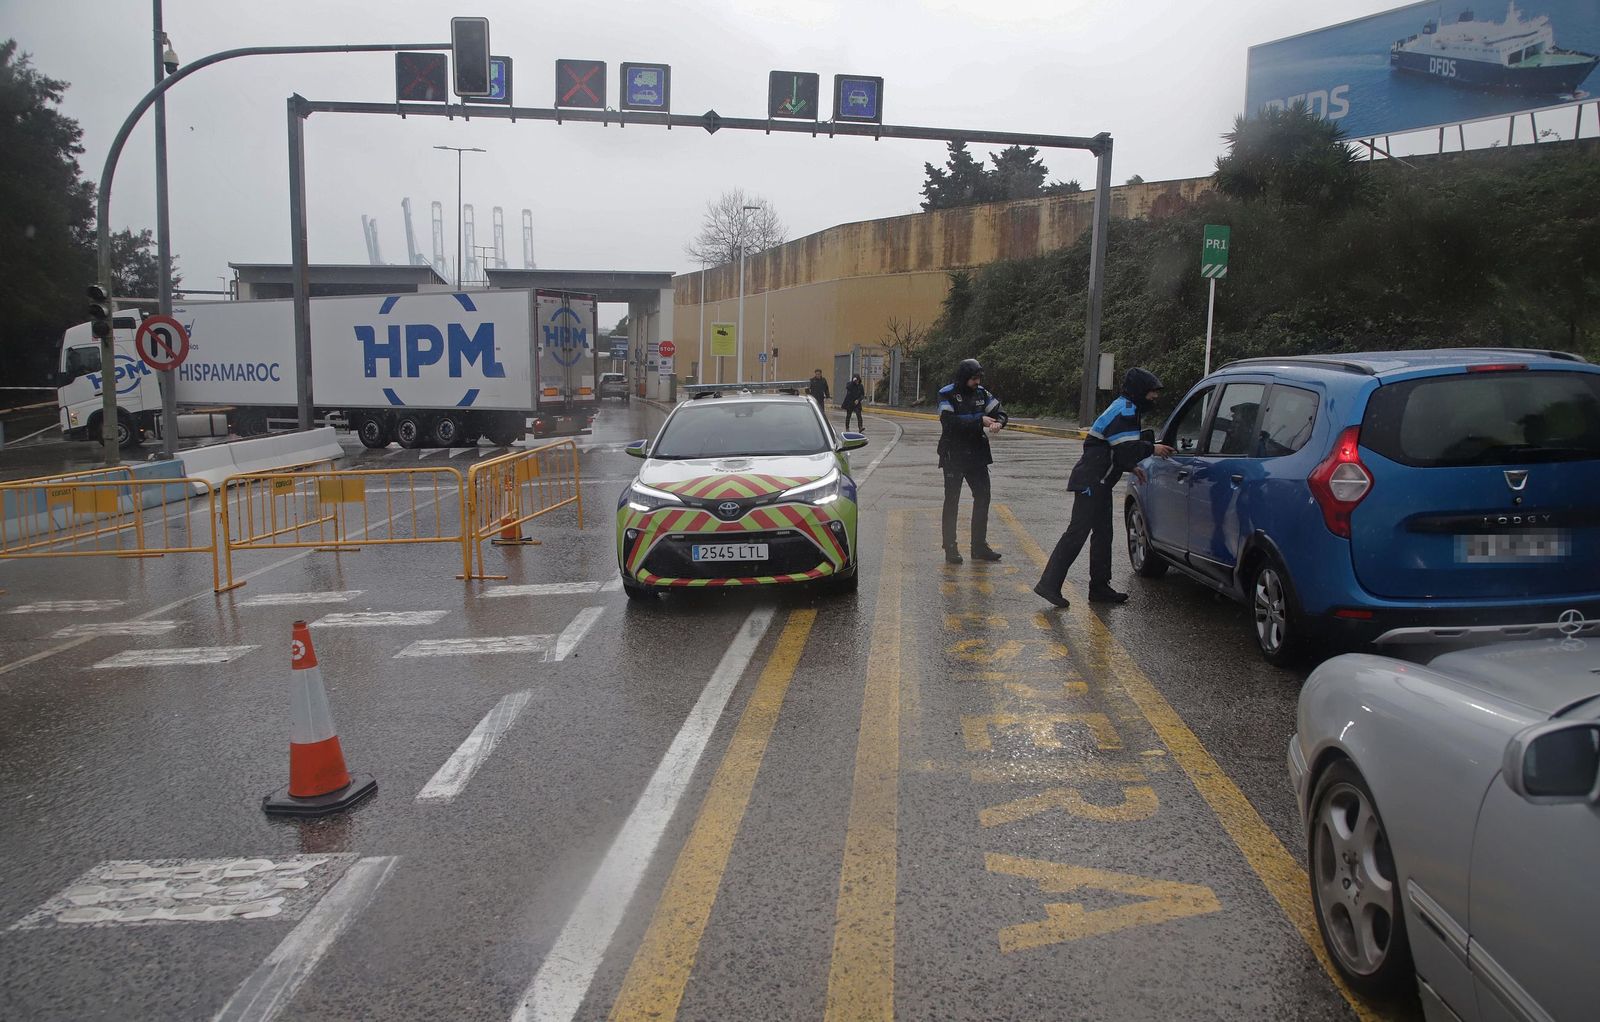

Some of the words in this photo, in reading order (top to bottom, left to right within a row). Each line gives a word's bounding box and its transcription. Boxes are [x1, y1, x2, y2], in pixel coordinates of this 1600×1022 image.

[1429, 56, 1457, 78] DFDS
[1205, 238, 1226, 250] PR1
[542, 325, 590, 349] HPM
[353, 322, 506, 378] HPM
[179, 362, 281, 382] HISPAMAROC
[1482, 514, 1551, 528] LODGY
[701, 546, 734, 559] 2545
[738, 546, 764, 559] LTL
